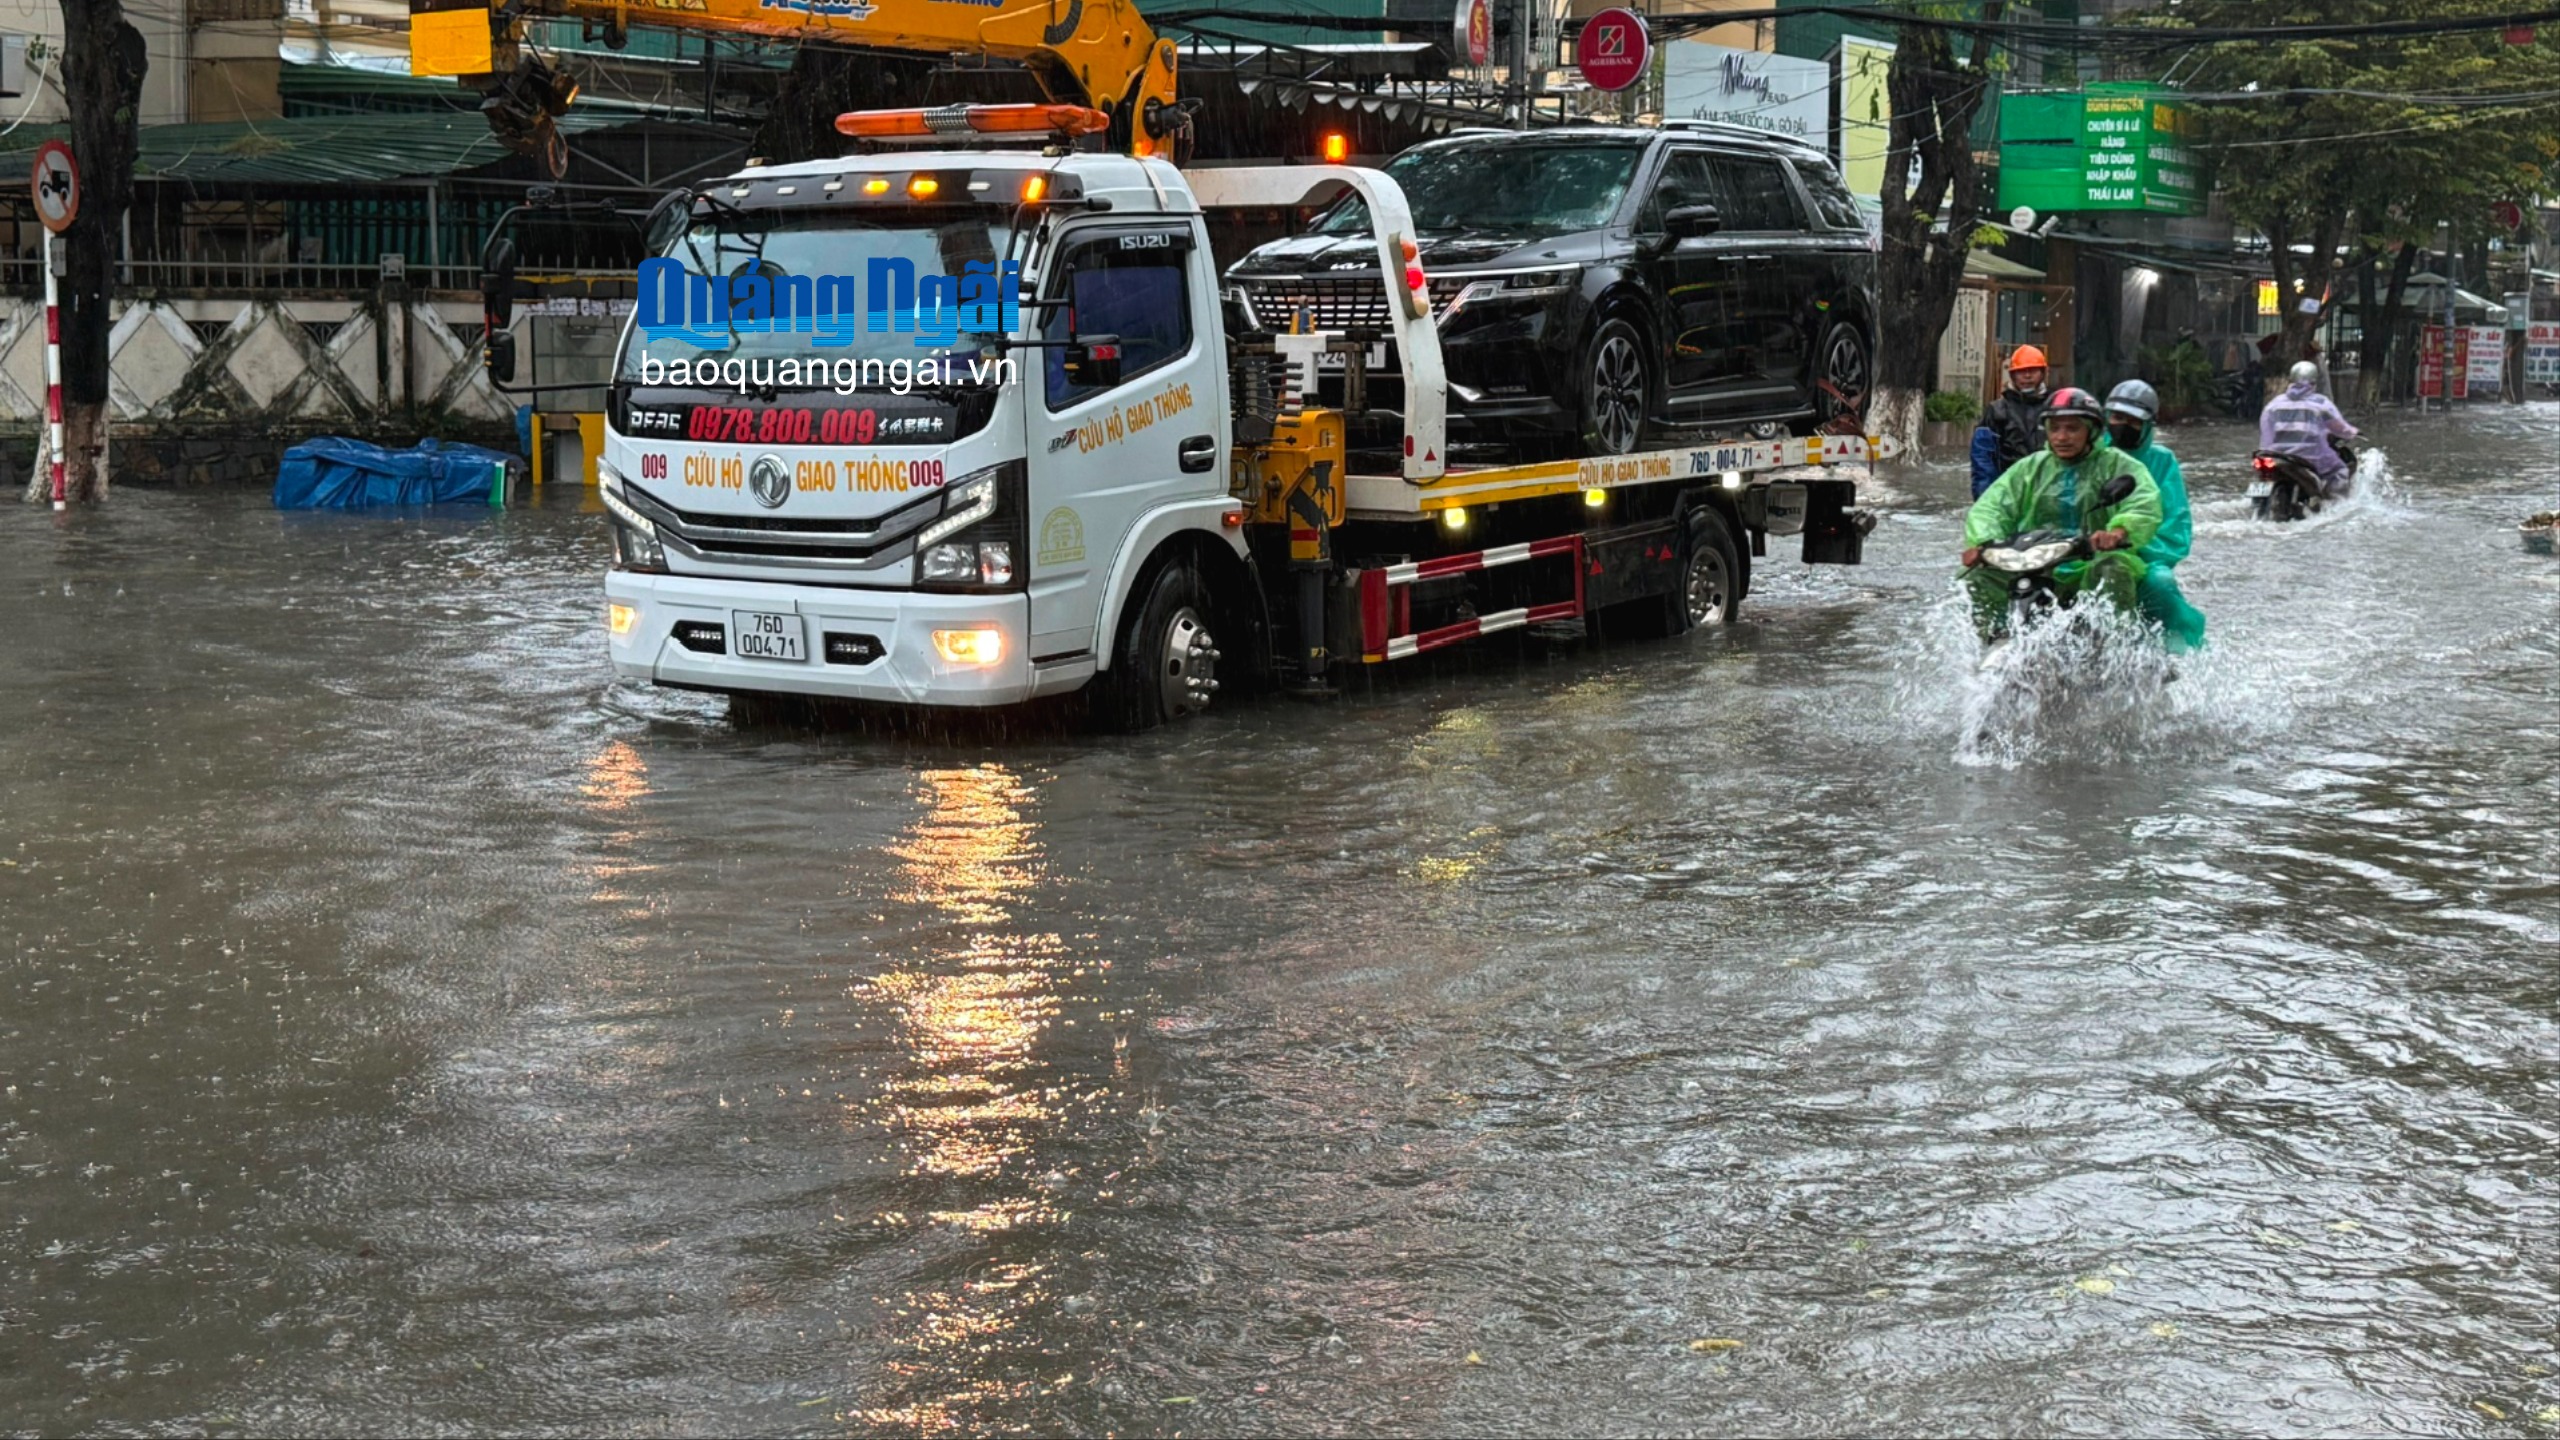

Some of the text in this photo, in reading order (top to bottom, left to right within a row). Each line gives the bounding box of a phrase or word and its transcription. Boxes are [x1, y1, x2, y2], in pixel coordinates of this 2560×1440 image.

[1588, 57, 1634, 66] AGRIBANK
[2087, 186, 2134, 200] THÁI LAN
[1120, 234, 1170, 249] ISUZU
[688, 406, 876, 443] 0978.800.009
[1077, 416, 1104, 455] CỨU
[1105, 405, 1124, 446] HỘ
[1126, 400, 1154, 433] GIAO
[1154, 382, 1193, 421] THÔNG
[642, 453, 667, 479] 009
[684, 450, 908, 496] CỨU HỘ GIAO THÔNG
[909, 459, 944, 487] 009
[1617, 460, 1639, 481] GIAO
[753, 614, 783, 633] 76D
[743, 634, 796, 657] 004.71
